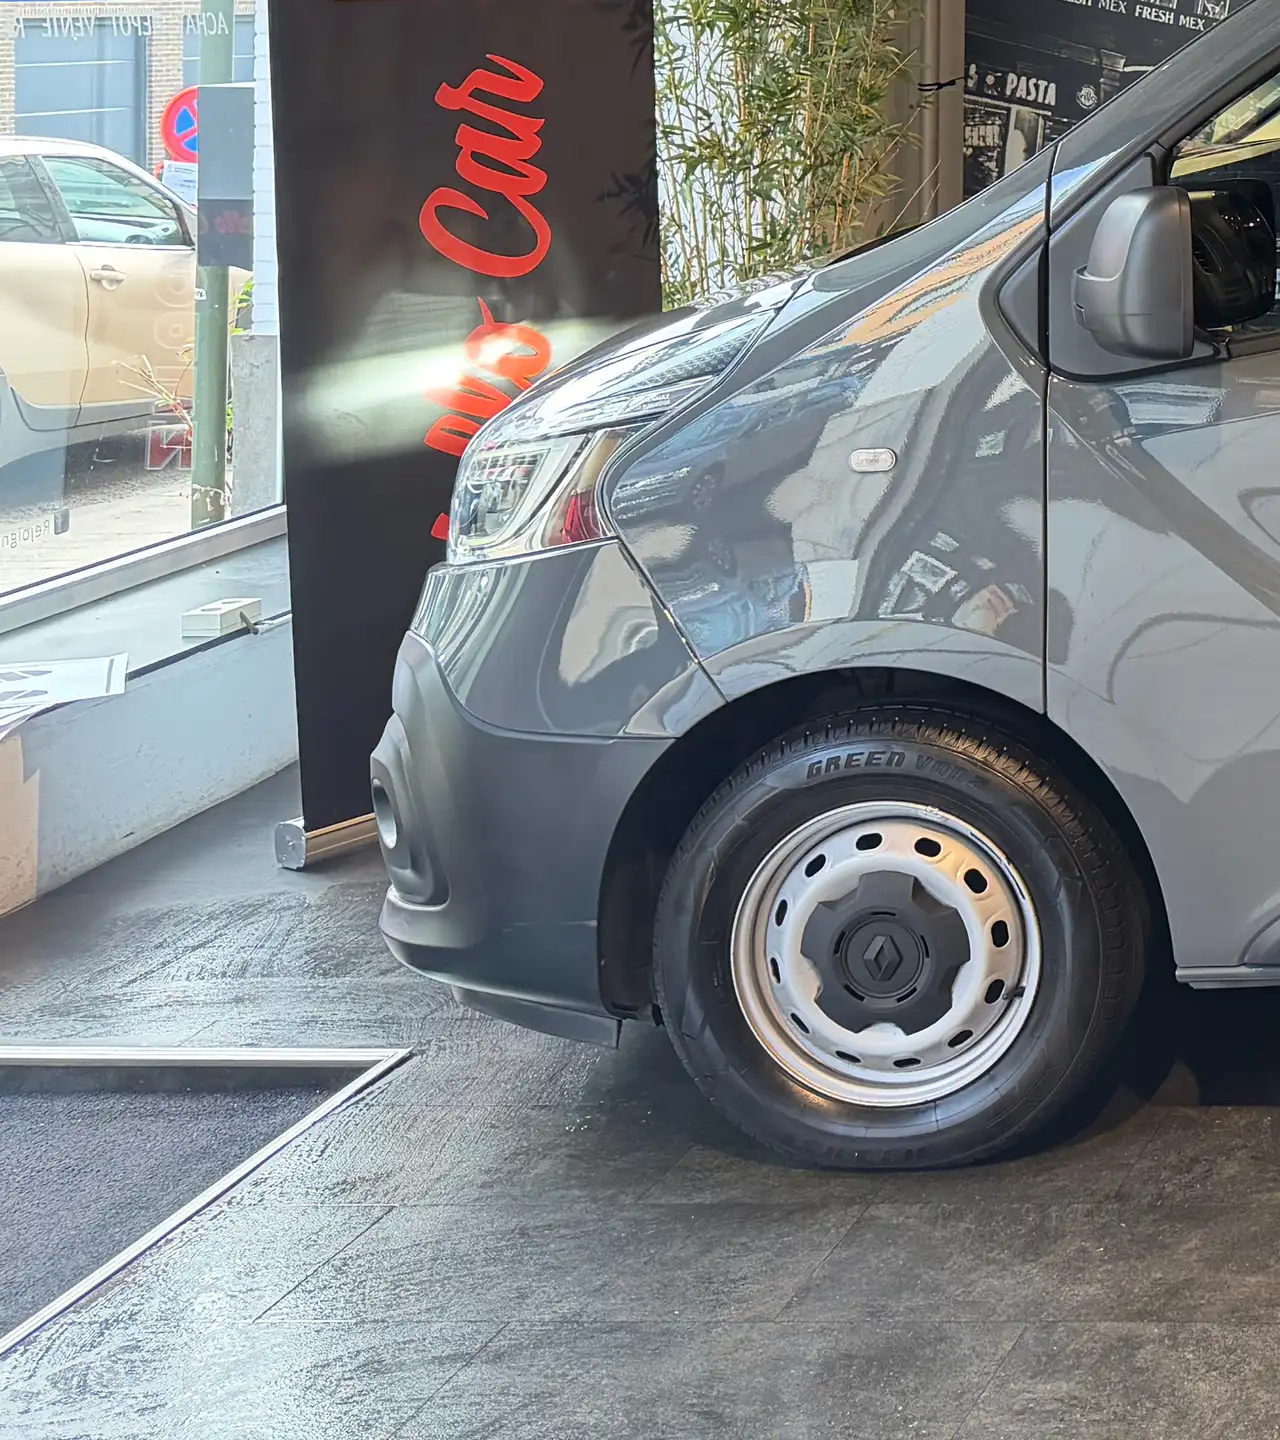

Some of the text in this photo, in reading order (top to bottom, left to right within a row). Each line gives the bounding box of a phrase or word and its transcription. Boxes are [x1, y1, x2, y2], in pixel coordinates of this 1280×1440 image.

[1134, 3, 1175, 25] FRESH
[1179, 13, 1206, 32] MEX
[1005, 72, 1057, 107] PASTA
[419, 53, 553, 278] Car
[806, 749, 907, 780] GREEN
